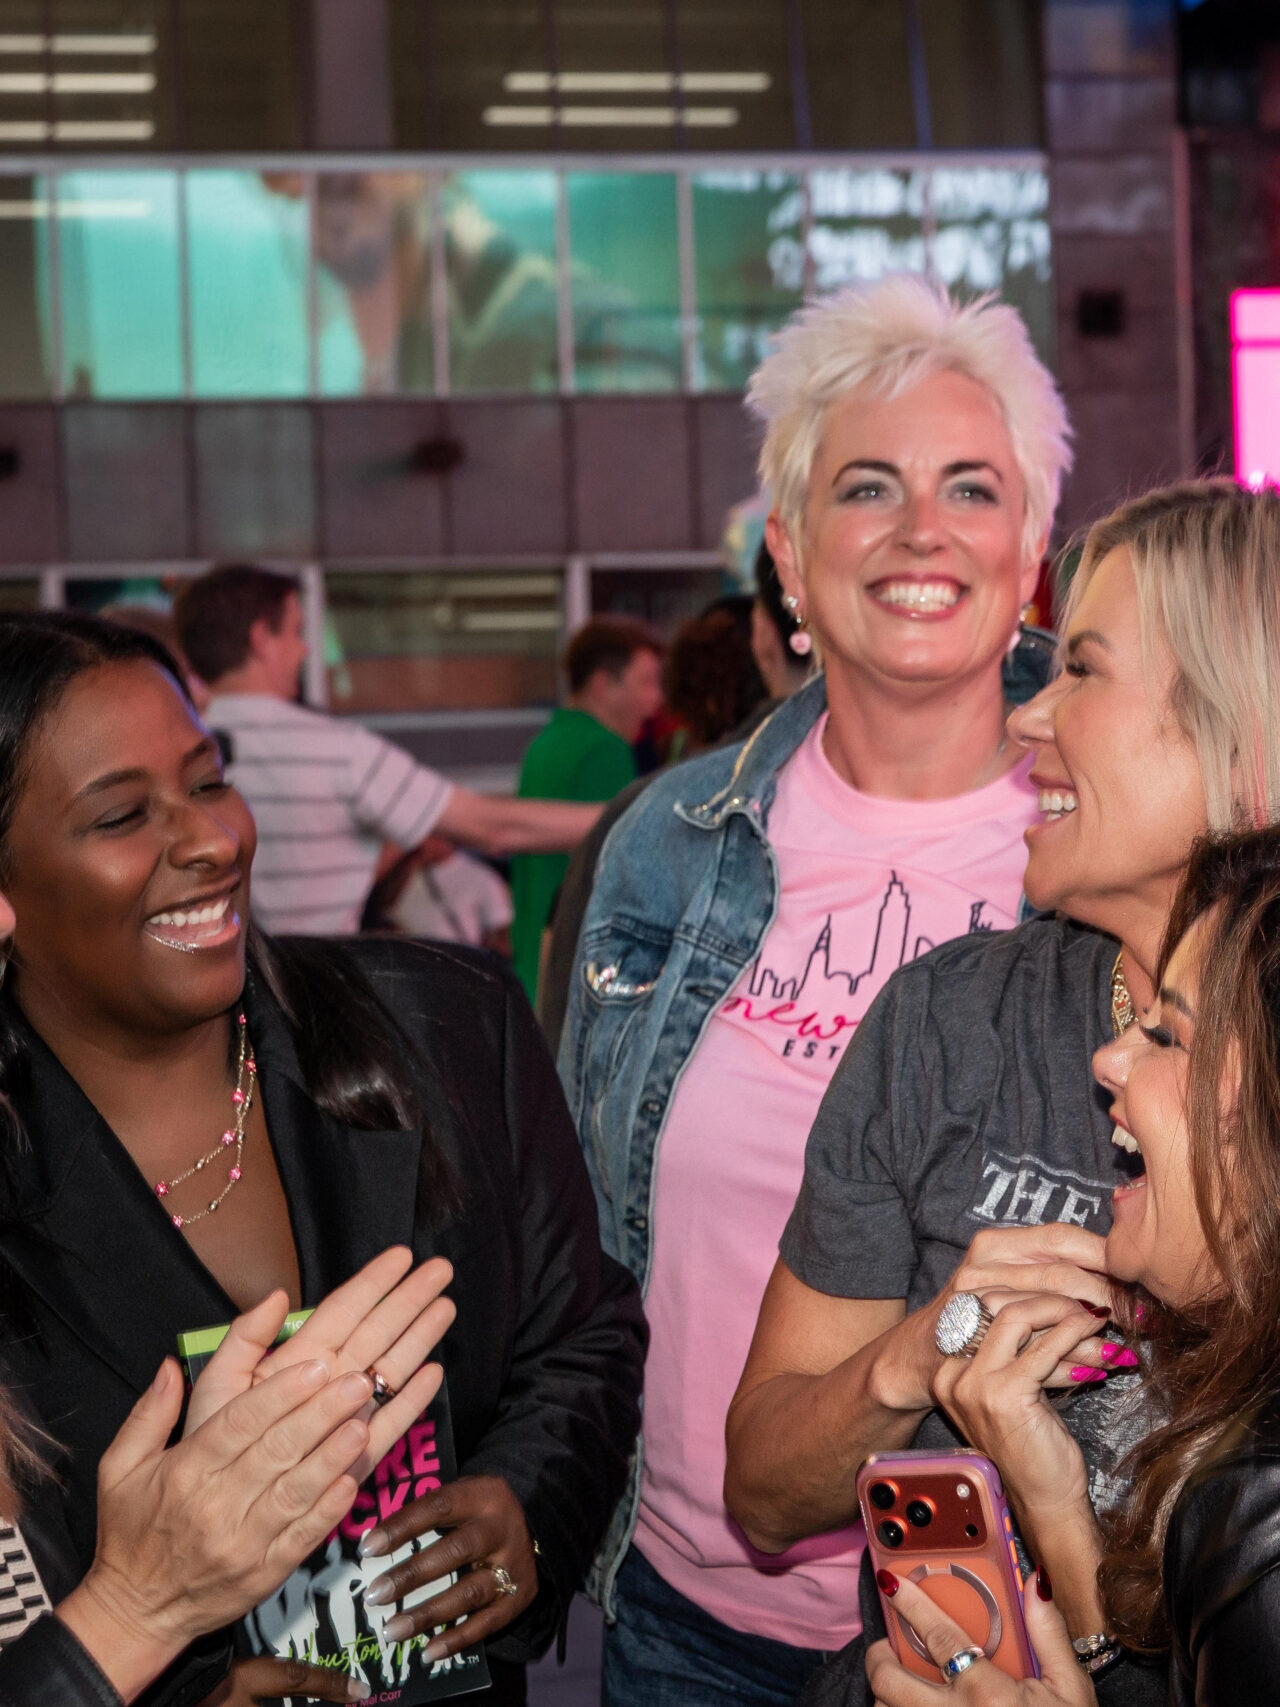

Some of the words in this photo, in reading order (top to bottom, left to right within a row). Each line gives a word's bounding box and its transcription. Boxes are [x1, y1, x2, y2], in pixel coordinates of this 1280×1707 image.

[722, 997, 858, 1039] new
[782, 1039, 840, 1059] EST
[972, 1161, 1101, 1228] THE
